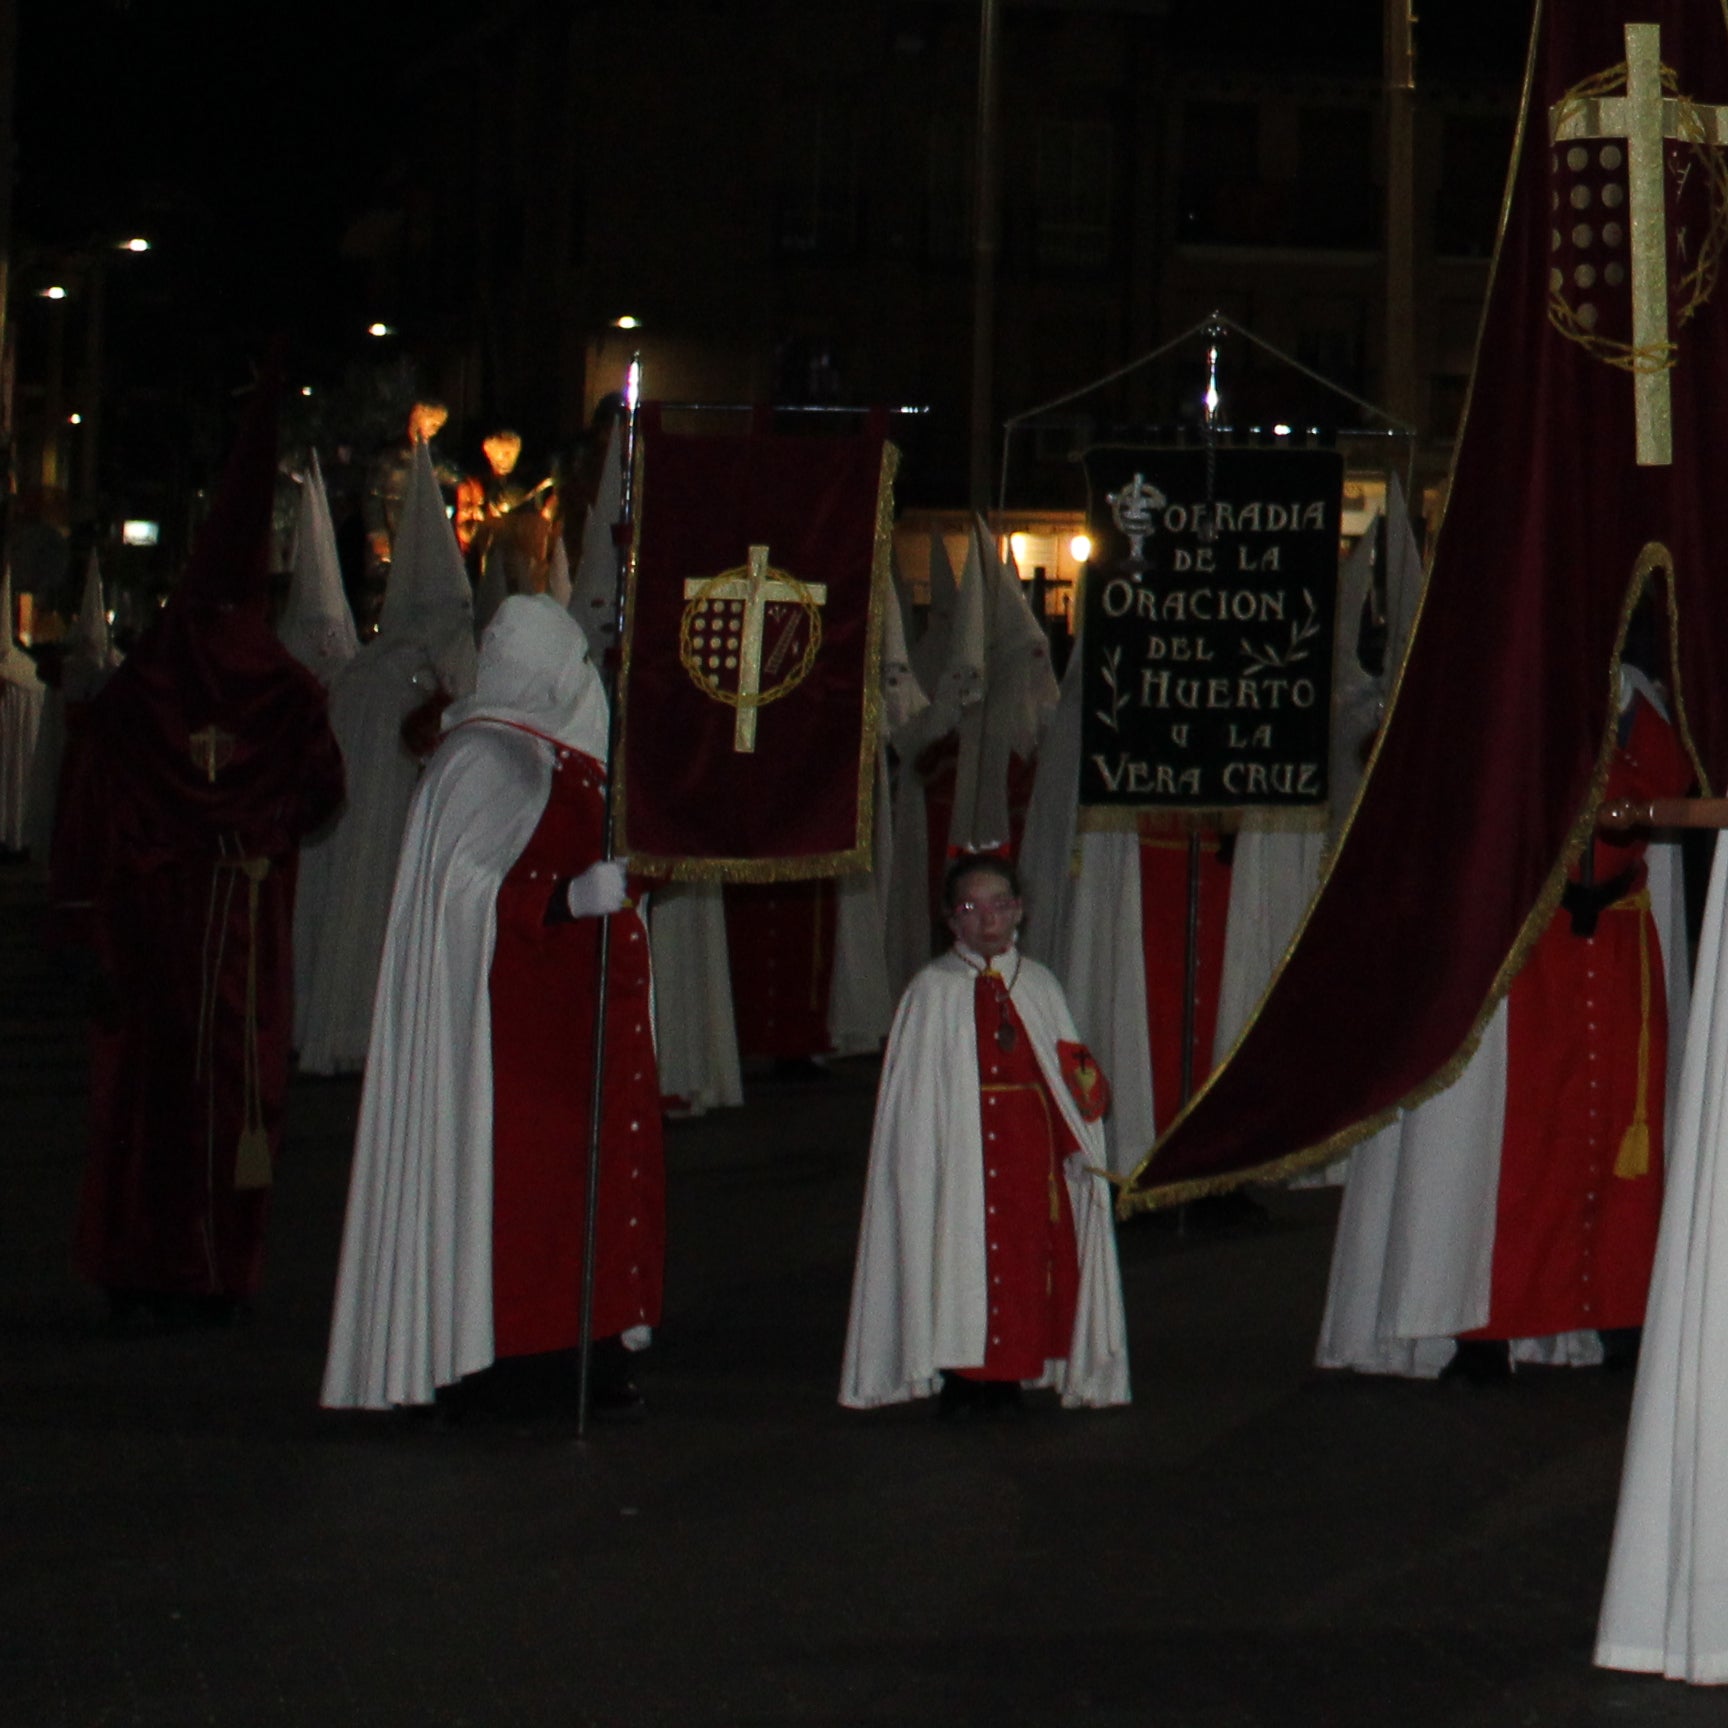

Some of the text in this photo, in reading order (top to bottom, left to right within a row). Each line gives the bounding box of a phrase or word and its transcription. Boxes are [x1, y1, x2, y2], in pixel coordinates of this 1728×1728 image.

[1174, 547, 1280, 571] DE LA
[1103, 579, 1285, 621] ORACION
[1148, 636, 1214, 660] DEL
[1141, 670, 1315, 708] HUERTO
[1230, 725, 1272, 748] LA
[1093, 754, 1321, 794] VERA CRUZ
